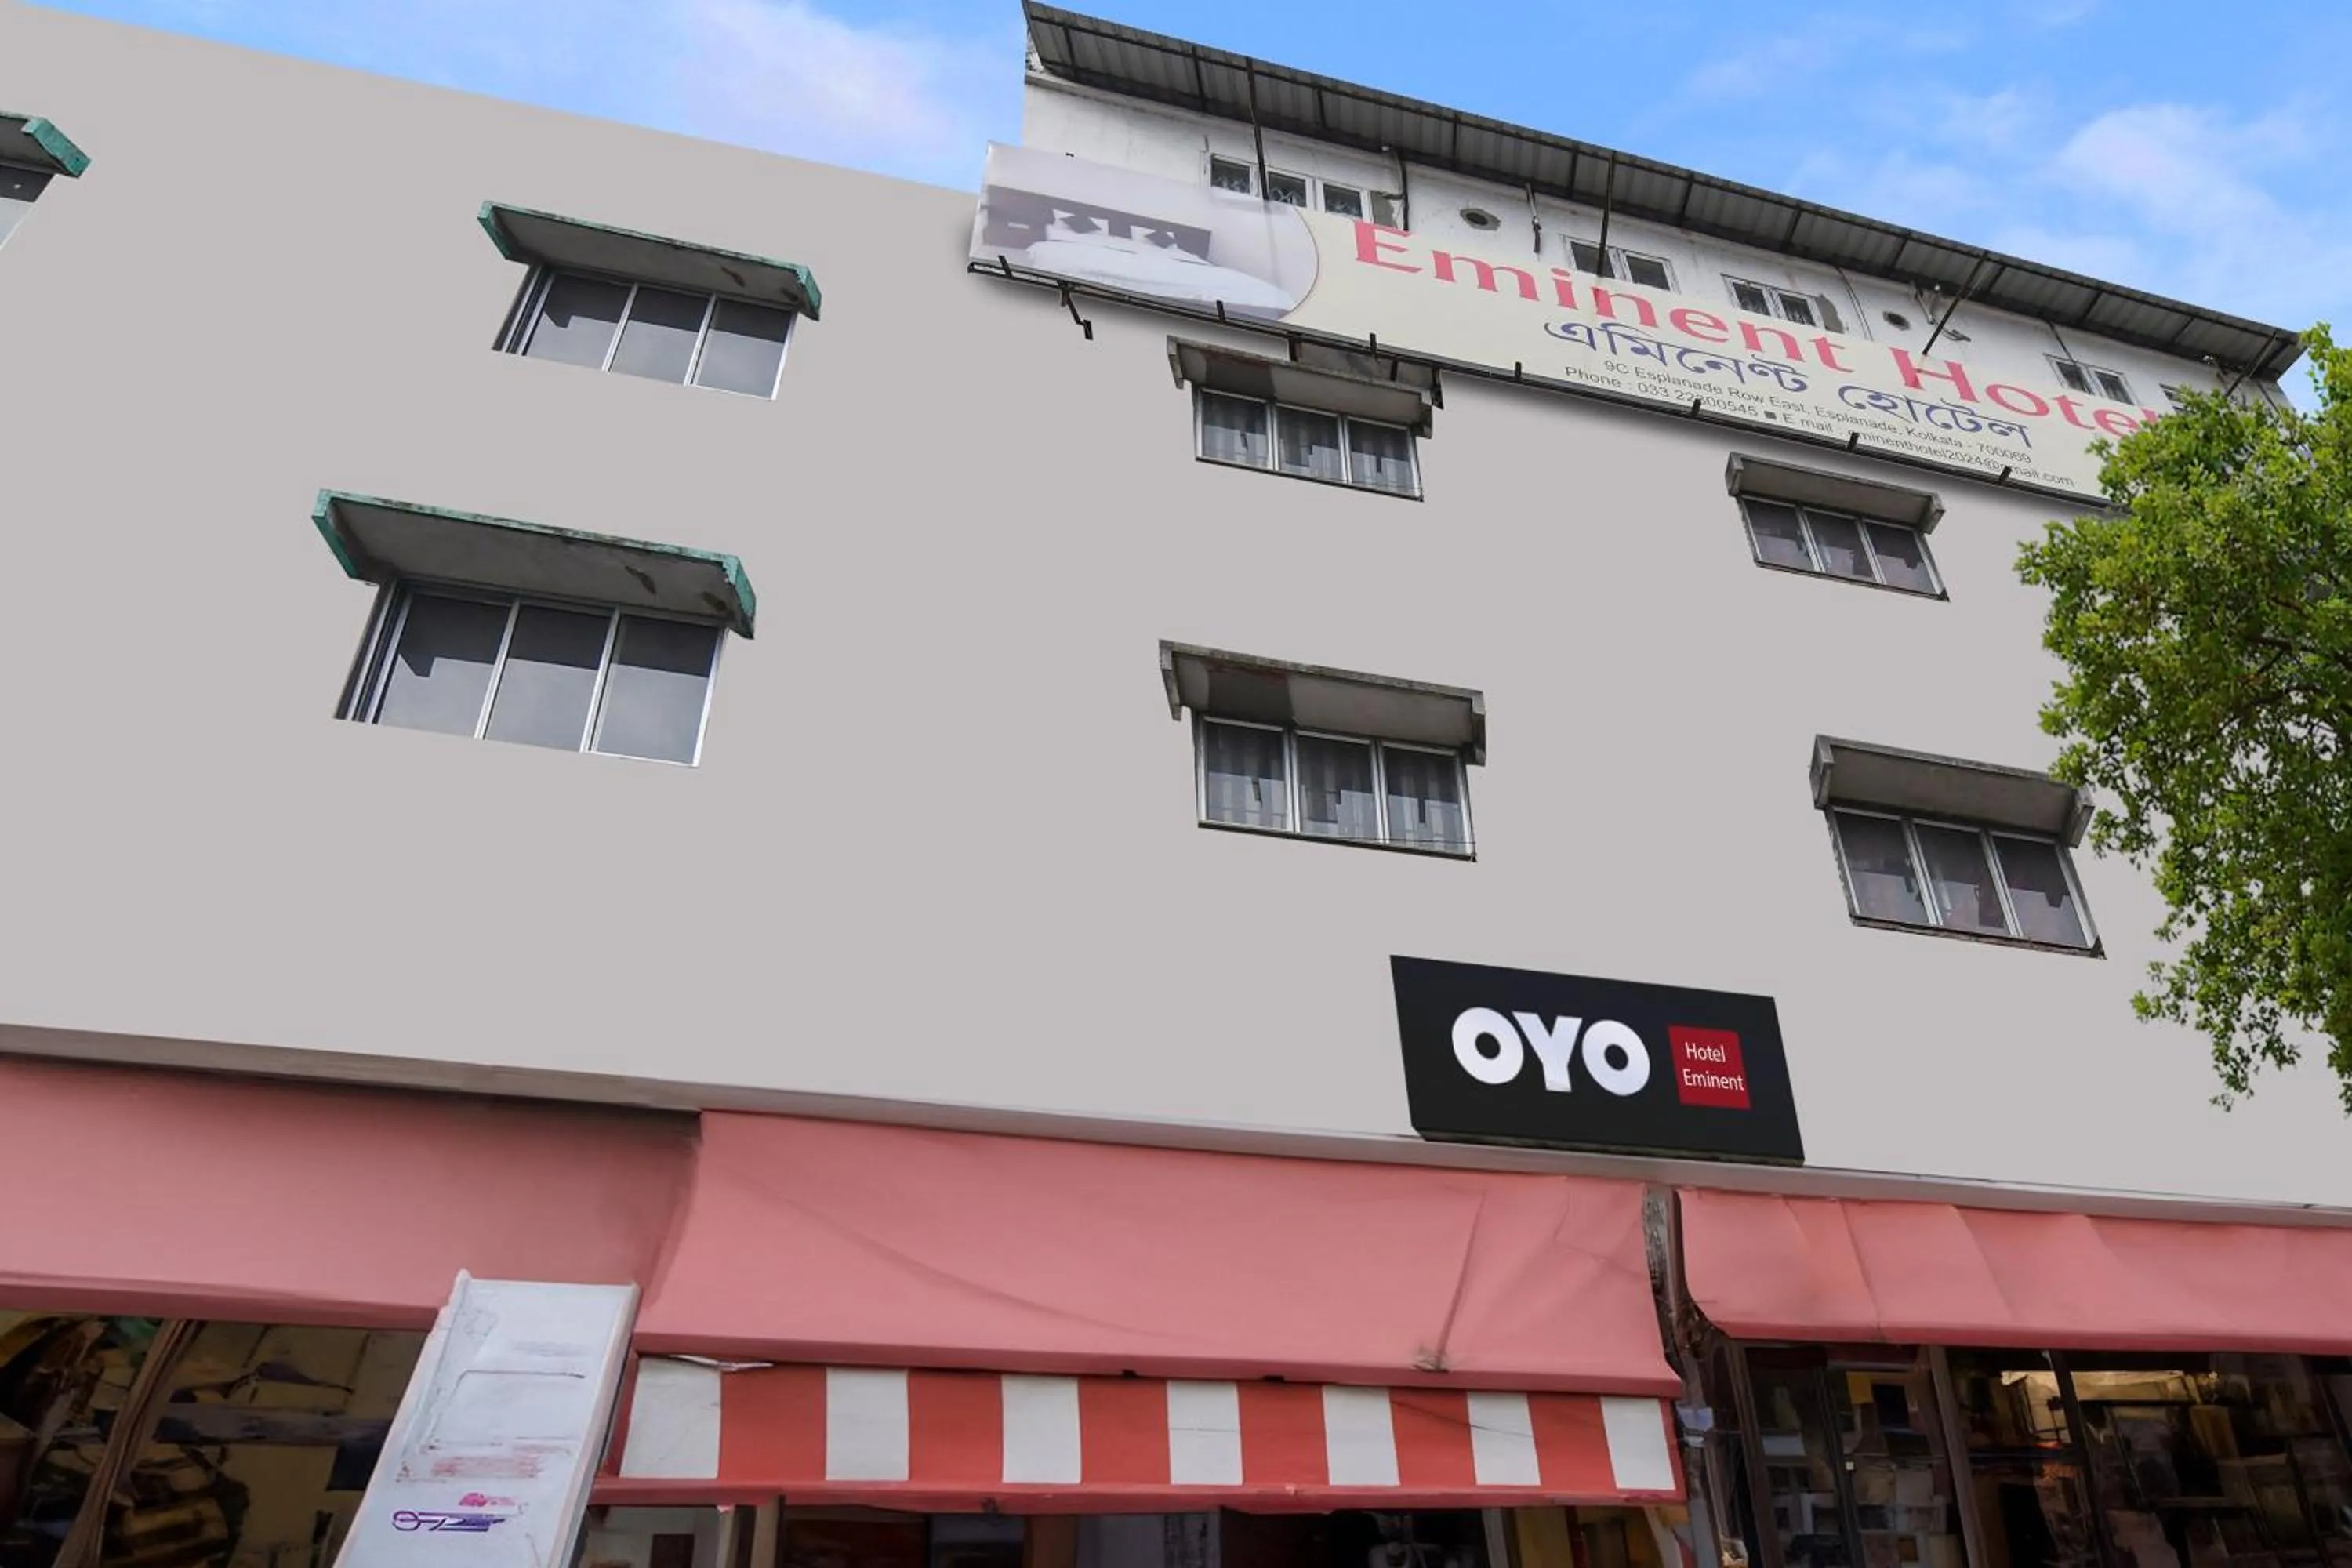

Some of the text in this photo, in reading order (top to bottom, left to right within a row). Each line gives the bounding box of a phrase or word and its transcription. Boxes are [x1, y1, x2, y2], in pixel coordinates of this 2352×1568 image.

[1354, 220, 2158, 439] Eminent Hote
[1565, 366, 1621, 388] Phone
[1638, 382, 1670, 398] 033
[1604, 360, 1630, 375] 9C
[1635, 366, 1723, 394] Esplanade
[1727, 387, 1764, 404] Row
[1907, 425, 1962, 448] Kolkata
[1838, 385, 2032, 449] হোটেল
[1452, 1007, 1650, 1096] OYO
[1682, 1068, 1745, 1092] Eminent
[1684, 1041, 1726, 1062] Hotel
